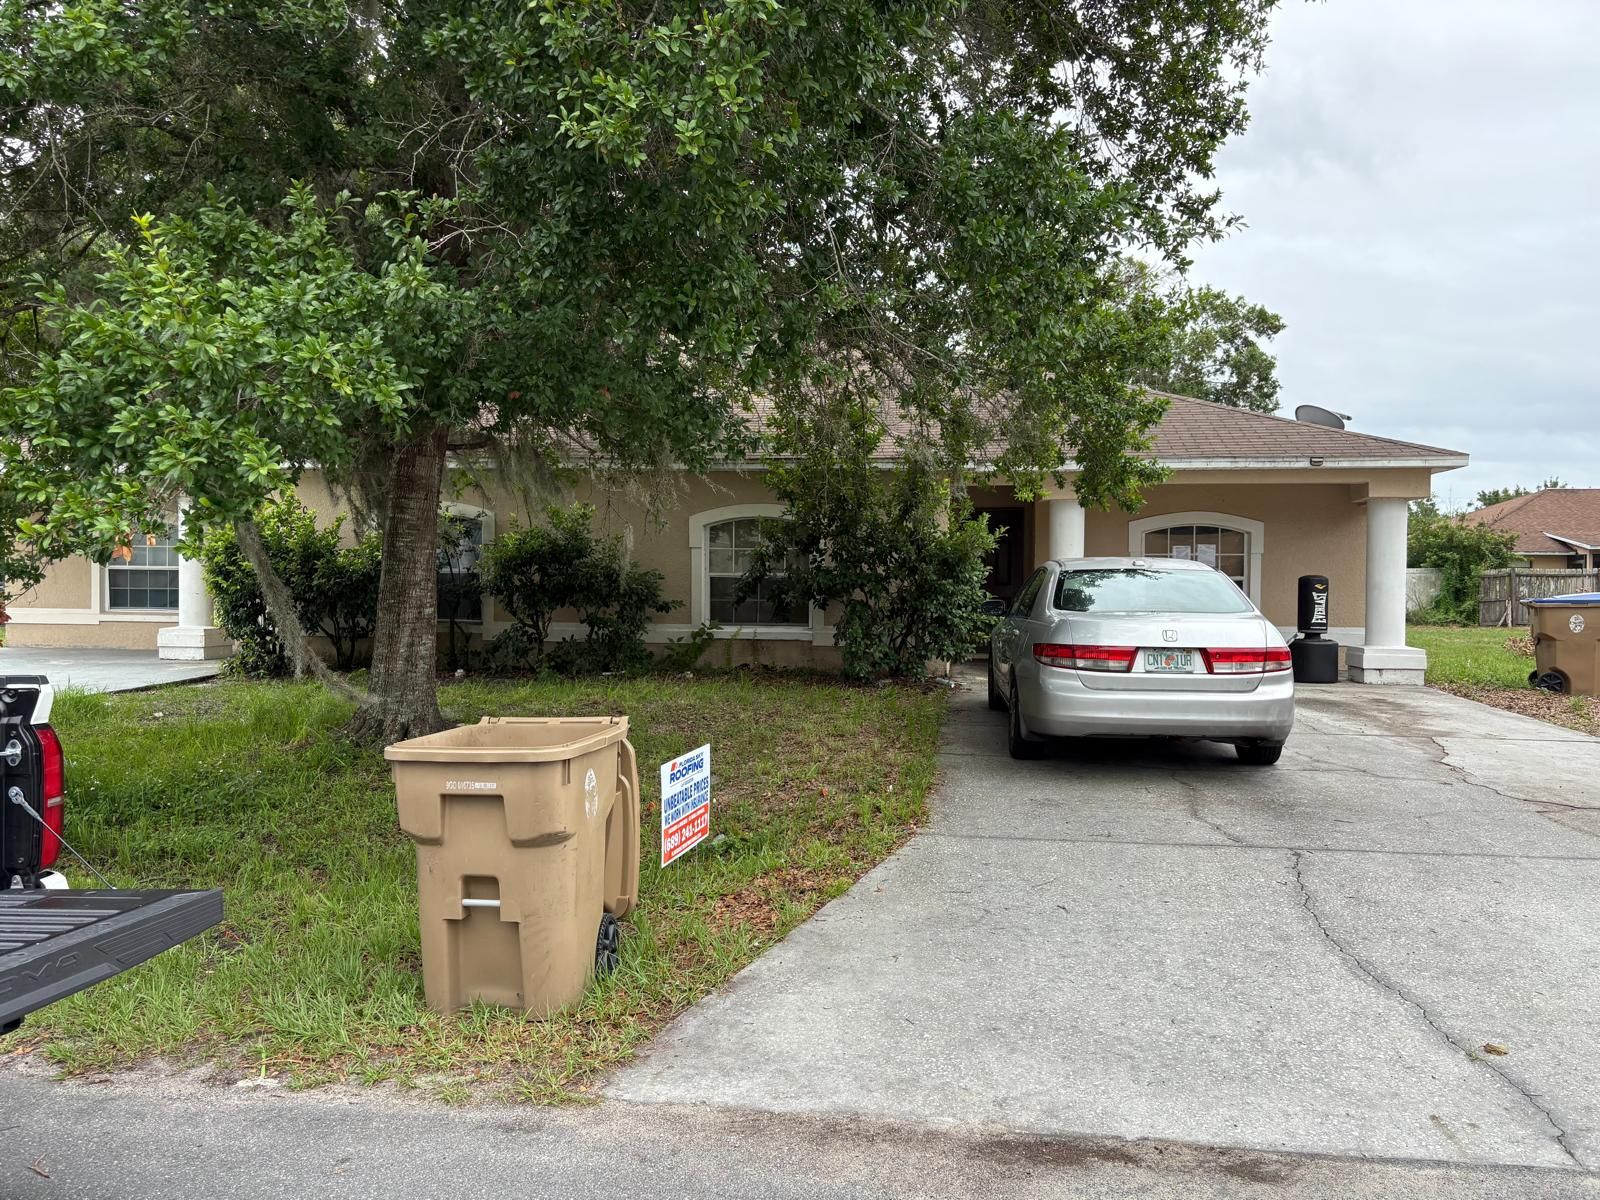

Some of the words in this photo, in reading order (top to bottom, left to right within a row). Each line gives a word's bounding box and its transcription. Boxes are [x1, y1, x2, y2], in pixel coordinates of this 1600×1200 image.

[1311, 591, 1327, 624] EVERLAST
[670, 758, 704, 784] ROOFING
[663, 784, 693, 814] UNBEATABLE
[693, 775, 709, 797] PRICES
[664, 829, 681, 853] (689)
